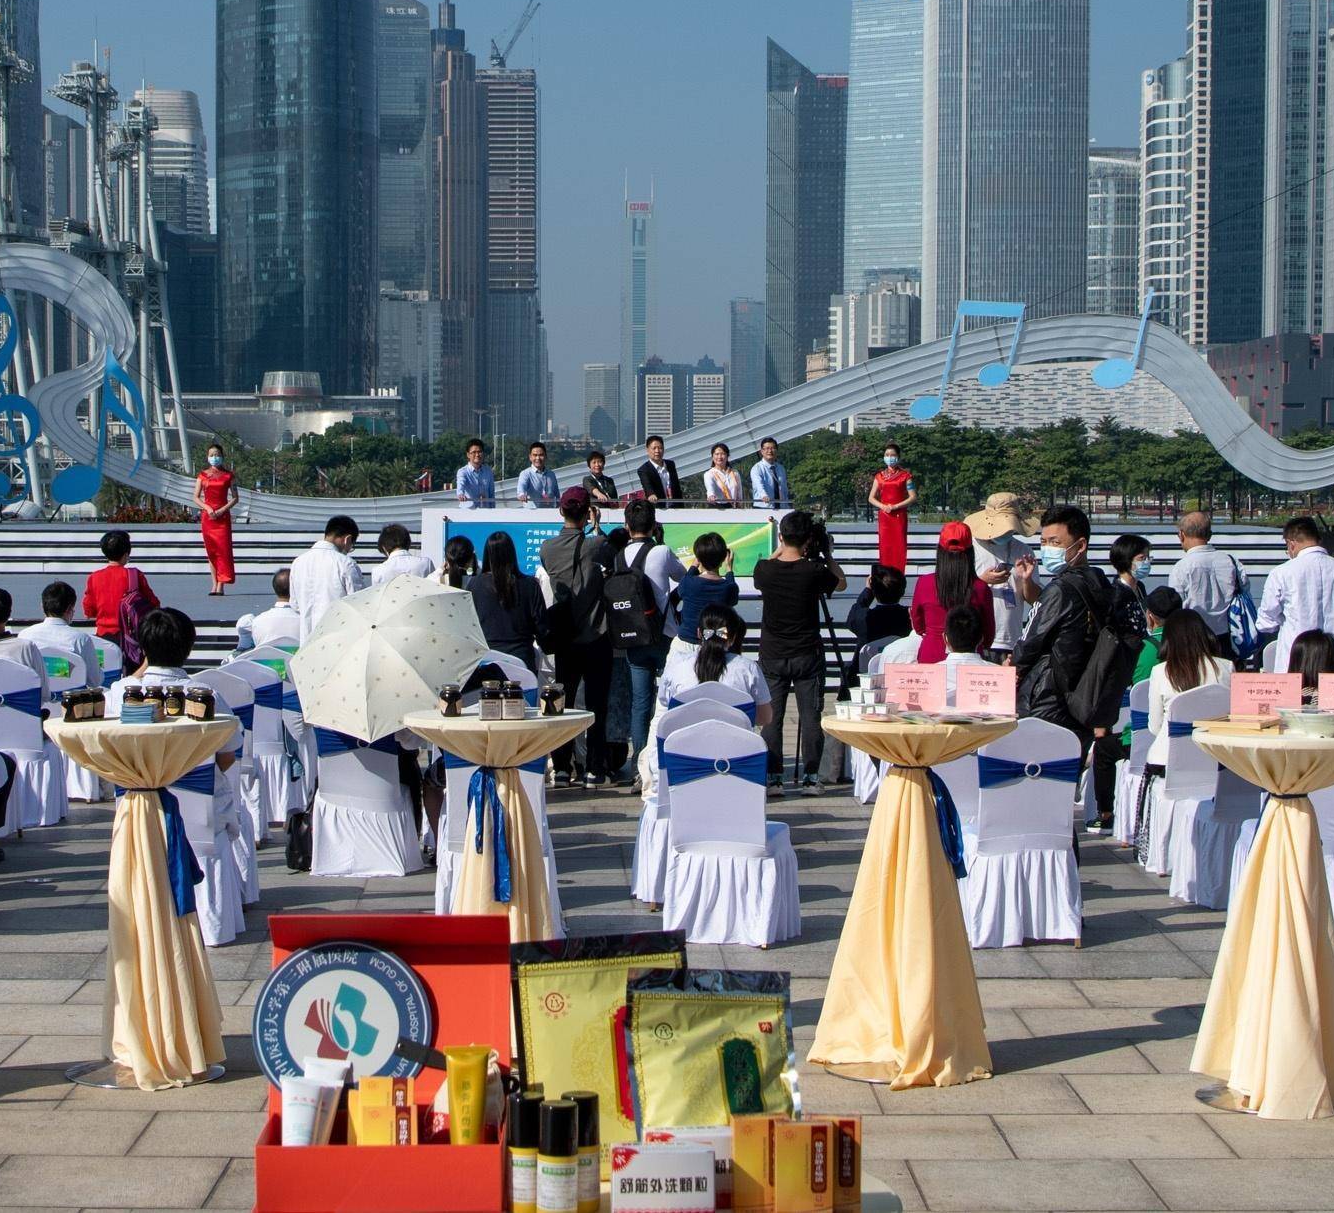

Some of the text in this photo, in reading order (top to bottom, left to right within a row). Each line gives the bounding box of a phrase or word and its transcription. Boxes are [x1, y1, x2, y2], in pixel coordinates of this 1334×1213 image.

[612, 600, 632, 610] EOS
[369, 956, 398, 980] GUCM
[394, 980, 409, 993] OF
[405, 993, 420, 1042] HOSPITAL
